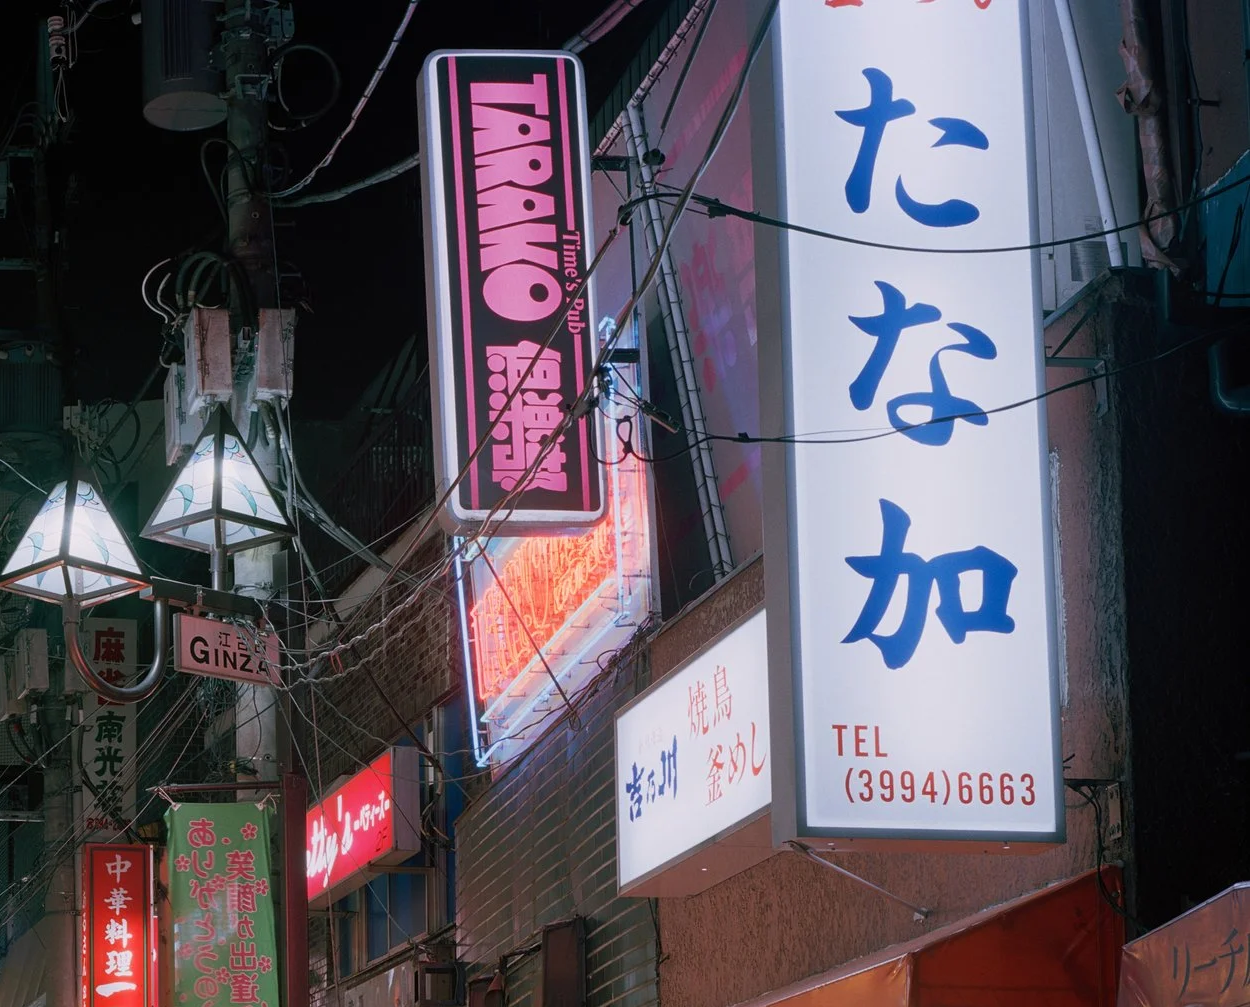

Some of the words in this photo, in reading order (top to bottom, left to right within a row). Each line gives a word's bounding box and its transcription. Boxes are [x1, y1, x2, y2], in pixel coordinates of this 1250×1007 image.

[470, 74, 562, 322] TARAKO
[563, 231, 583, 295] Time's
[566, 298, 586, 334] Pub
[835, 68, 1017, 669] たな加
[190, 636, 271, 677] GINZA
[688, 665, 733, 739] 焼鳥
[705, 722, 767, 806] 釜めし
[832, 725, 887, 757] TEL
[845, 767, 1035, 806] (3994)6663
[104, 854, 133, 977] 中華料理
